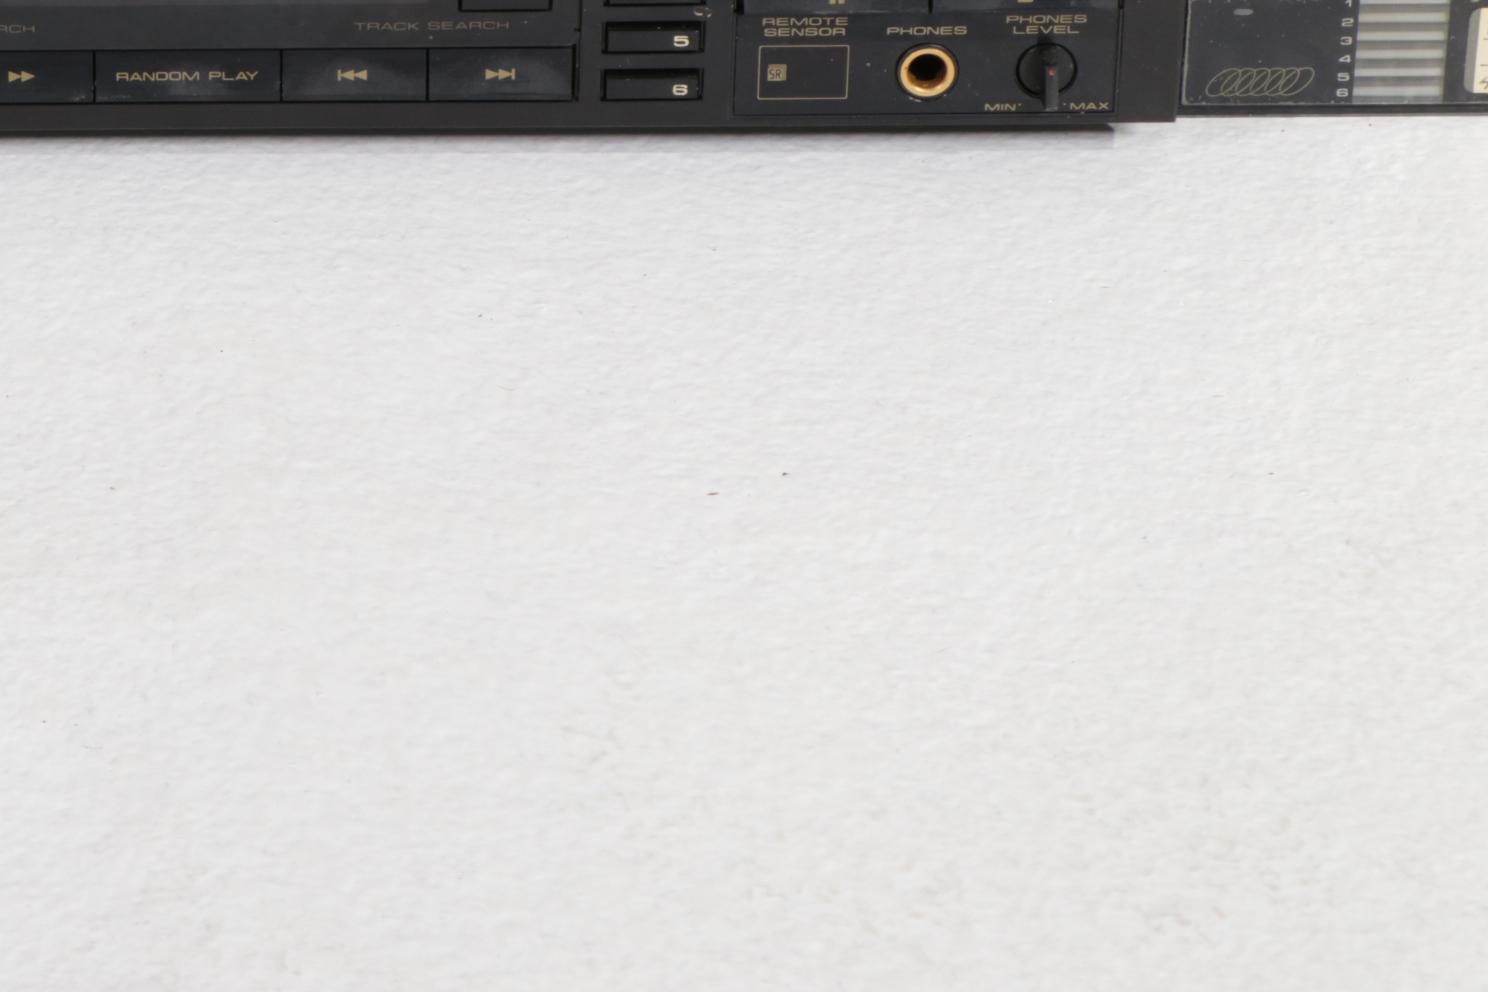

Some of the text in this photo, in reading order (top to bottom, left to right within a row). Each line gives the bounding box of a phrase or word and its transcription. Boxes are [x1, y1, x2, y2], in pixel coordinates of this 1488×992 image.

[762, 17, 849, 26] REMOTE
[1006, 14, 1088, 25] PHONES
[354, 20, 510, 31] TRACK SEARCH
[1013, 25, 1080, 35] LEVEL
[764, 28, 846, 37] SENSOR
[887, 26, 968, 36] PHONES
[673, 35, 689, 47] 5
[116, 70, 258, 82] RANDOM PLAY
[672, 84, 688, 96] 6
[1069, 101, 1110, 111] MAX
